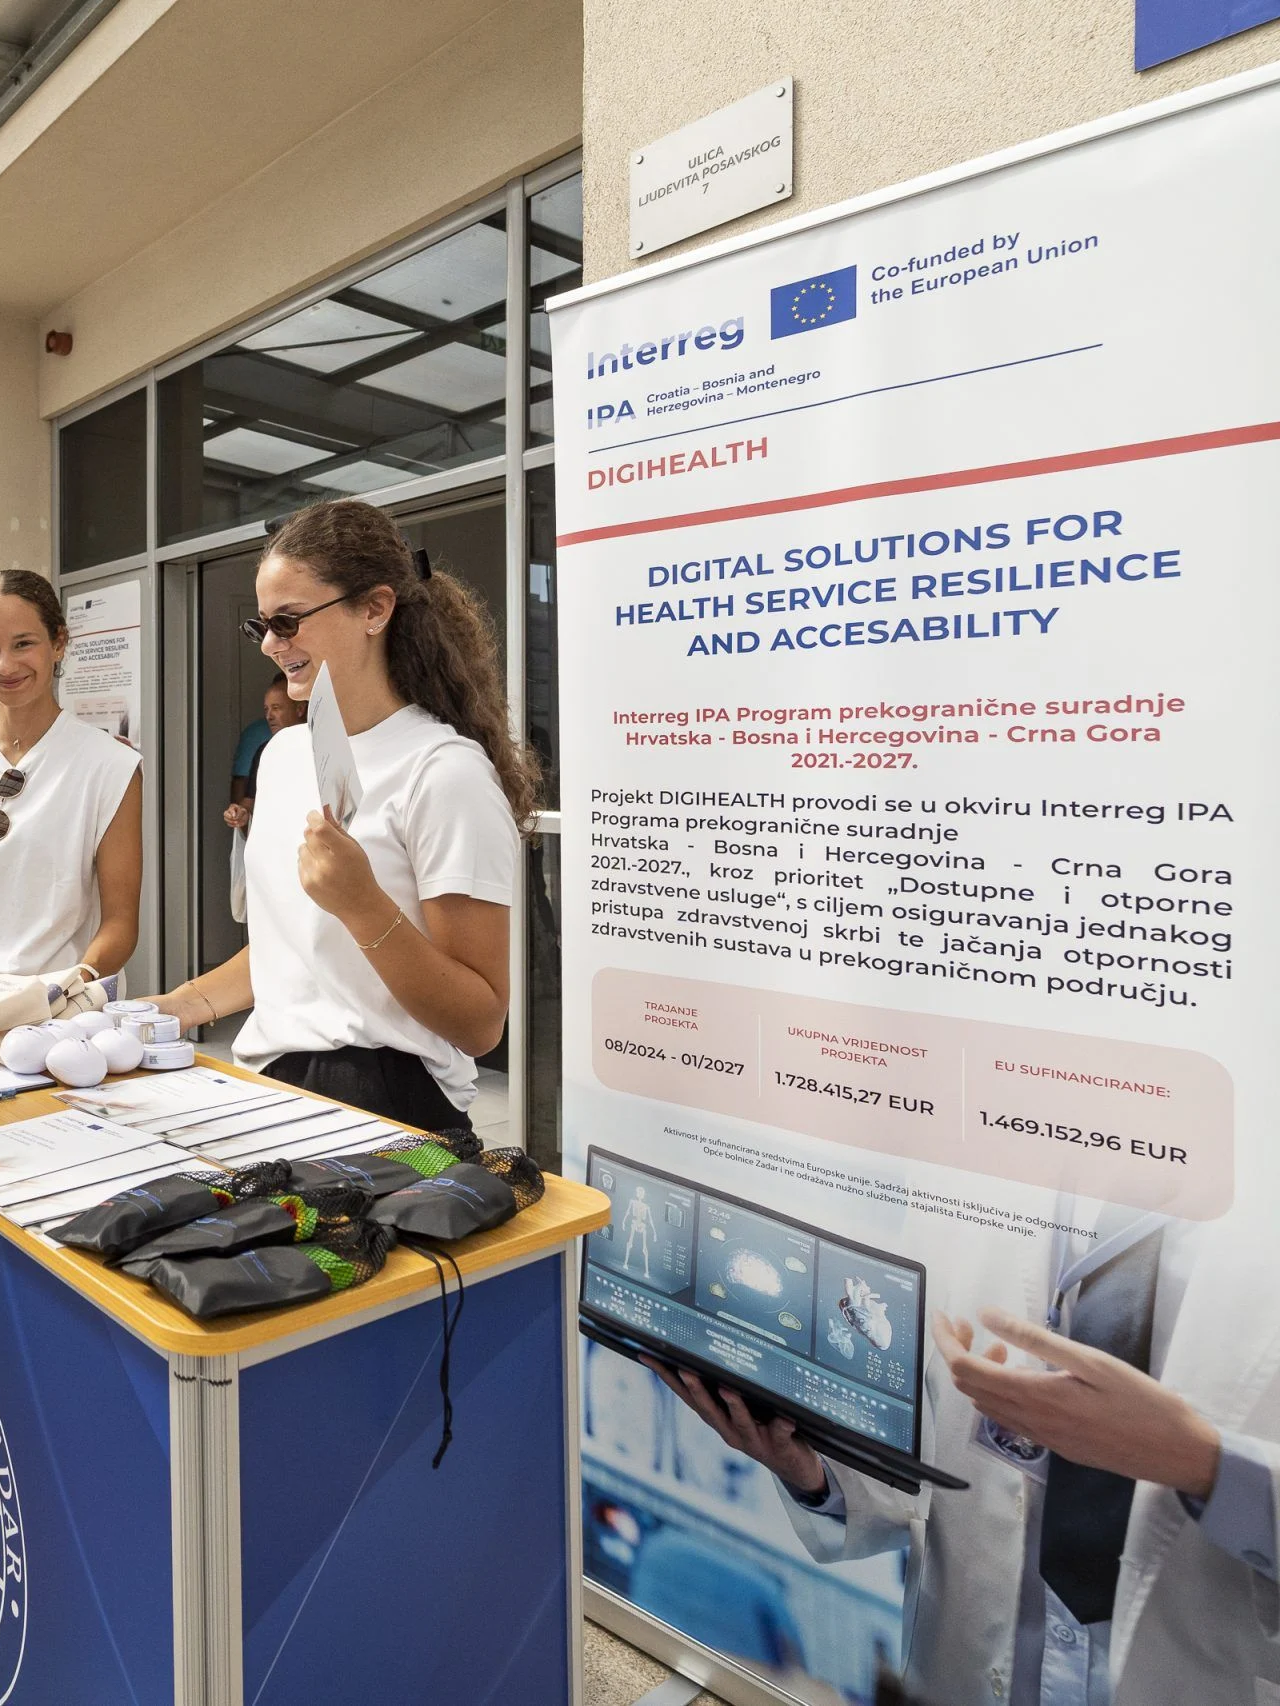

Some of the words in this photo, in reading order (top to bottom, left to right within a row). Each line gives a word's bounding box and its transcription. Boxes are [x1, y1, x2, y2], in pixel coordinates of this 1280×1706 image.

[638, 172, 700, 207] LJUDEVITA
[702, 135, 781, 179] POSAVSKOG
[688, 146, 724, 169] ULICA
[702, 182, 710, 194] 7
[871, 288, 903, 304] the
[912, 258, 1018, 295] European
[1028, 236, 1098, 264] Union
[872, 238, 984, 281] Co-funded
[993, 232, 1020, 250] by
[587, 315, 745, 380] Interreg
[646, 386, 690, 403] Croatia
[702, 373, 745, 391] Bosnia
[749, 364, 775, 380] and
[647, 392, 724, 416] Herzegovina
[736, 370, 820, 396] Montenegro
[587, 399, 637, 430] IPA
[587, 436, 769, 490] DIGIHEALTH
[648, 553, 774, 588] DIGITAL
[784, 523, 1010, 572] SOLUTIONS
[1027, 510, 1122, 545] FOR
[616, 594, 734, 626] HEALTH
[746, 578, 896, 614] SERVICE
[912, 550, 1181, 600] RESILIENCE
[686, 631, 760, 656] AND
[770, 607, 1060, 651] ACCESABILITY
[614, 711, 688, 726] Interreg
[696, 708, 730, 722] IPA
[737, 707, 831, 725] Program
[840, 698, 1036, 723] prekogranične
[1046, 692, 1185, 718] suradnje
[626, 730, 712, 746] Hrvatska
[732, 730, 798, 745] Bosna
[806, 728, 811, 744] i
[819, 725, 979, 748] Hercegovina
[1007, 726, 1076, 743] Crna
[1086, 724, 1160, 742] Gora
[791, 752, 918, 769] 2021.-2027.
[592, 789, 654, 807] Projekt
[660, 791, 784, 808] DIGIHEALTH
[792, 794, 876, 812] provodi
[885, 800, 912, 812] se
[921, 800, 936, 813] u
[945, 797, 1030, 816] okviru
[1042, 800, 1164, 824] Interreg
[1178, 802, 1234, 822] IPA
[592, 811, 679, 829] Programa
[686, 815, 840, 836] prekogranične
[846, 822, 958, 844] suradnje
[592, 833, 668, 851] Hrvatska
[714, 840, 778, 858] Bosna
[799, 843, 804, 859] i
[826, 846, 984, 870] Hercegovina
[1051, 858, 1121, 878] Crna
[1154, 863, 1232, 885] Gora
[591, 855, 690, 878] 2021.-2027.,
[710, 862, 754, 880] kroz
[775, 868, 864, 890] prioritet
[888, 877, 1034, 902] „Dostupne
[1064, 886, 1070, 904] i
[1101, 892, 1233, 916] otporne
[591, 878, 700, 900] zdravstvene
[707, 888, 790, 911] usluge“,
[797, 898, 807, 910] s
[814, 896, 883, 918] ciljem
[892, 904, 1068, 936] osiguravanja
[1076, 916, 1231, 952] jednakog
[592, 899, 663, 921] pristupa
[677, 908, 808, 939] zdravstvenoj
[823, 923, 880, 944] skrbi
[898, 931, 924, 948] te
[940, 933, 1041, 962] jačanja
[1064, 948, 1232, 980] otpornosti
[592, 922, 707, 948] zdravstvenih
[714, 938, 791, 958] sustava
[799, 948, 811, 961] u
[820, 951, 1036, 988] prekograničnom
[1048, 976, 1196, 1007] području.
[644, 1001, 698, 1017] TRAJANJE
[644, 1014, 698, 1031] PROJEKTA
[605, 1038, 666, 1061] 08/2024
[681, 1053, 744, 1076] 01/2027
[788, 1026, 839, 1044] UKUPNA
[842, 1036, 928, 1058] VRIJEDNOST
[821, 1047, 888, 1068] PROJEKTA
[775, 1071, 882, 1105] 1.728.415,27
[889, 1095, 934, 1116] EUR
[995, 1060, 1015, 1072] EU
[1020, 1064, 1170, 1098] SUFINANCIRANJE:
[980, 1110, 1122, 1151] 1.469.152,96
[1131, 1139, 1187, 1164] EUR
[663, 1126, 698, 1141] Aktivnost
[699, 1136, 707, 1144] je
[708, 1138, 760, 1156] sufinancirana
[761, 1152, 805, 1168] sredstvima
[806, 1162, 846, 1180] Europske
[847, 1175, 872, 1186] unije.
[874, 1180, 909, 1197] Sadržaj
[912, 1189, 960, 1206] aktivnosti
[962, 1200, 1010, 1218] isključiva
[1012, 1213, 1023, 1222] je
[1025, 1216, 1098, 1240] odgovornost
[703, 1146, 724, 1158] Opće
[725, 1152, 754, 1165] bolnice
[755, 1159, 778, 1172] Zadar
[784, 1169, 795, 1177] ne
[796, 1172, 834, 1188] odražava
[836, 1184, 864, 1196] nužno
[866, 1190, 908, 1206] službena
[910, 1202, 954, 1217] stajališta
[956, 1210, 1004, 1230] Europske
[1007, 1224, 1036, 1237] unije.
